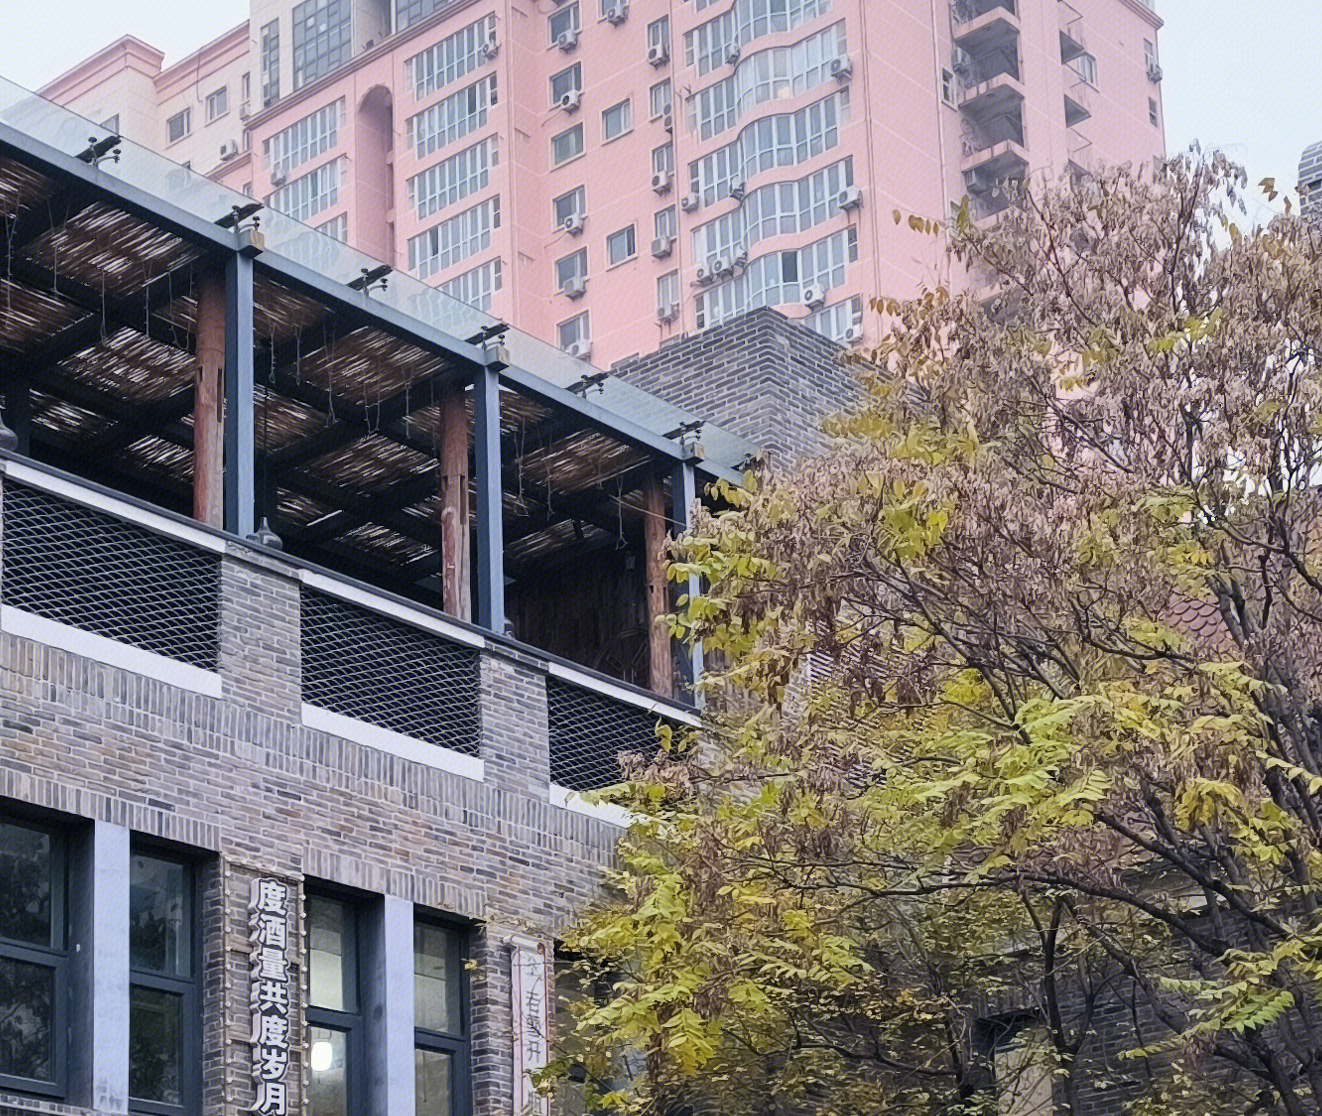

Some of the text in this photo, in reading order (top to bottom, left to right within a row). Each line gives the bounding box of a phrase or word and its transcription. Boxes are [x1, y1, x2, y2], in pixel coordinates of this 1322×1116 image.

[257, 879, 289, 1116] 度酒量共度岁月
